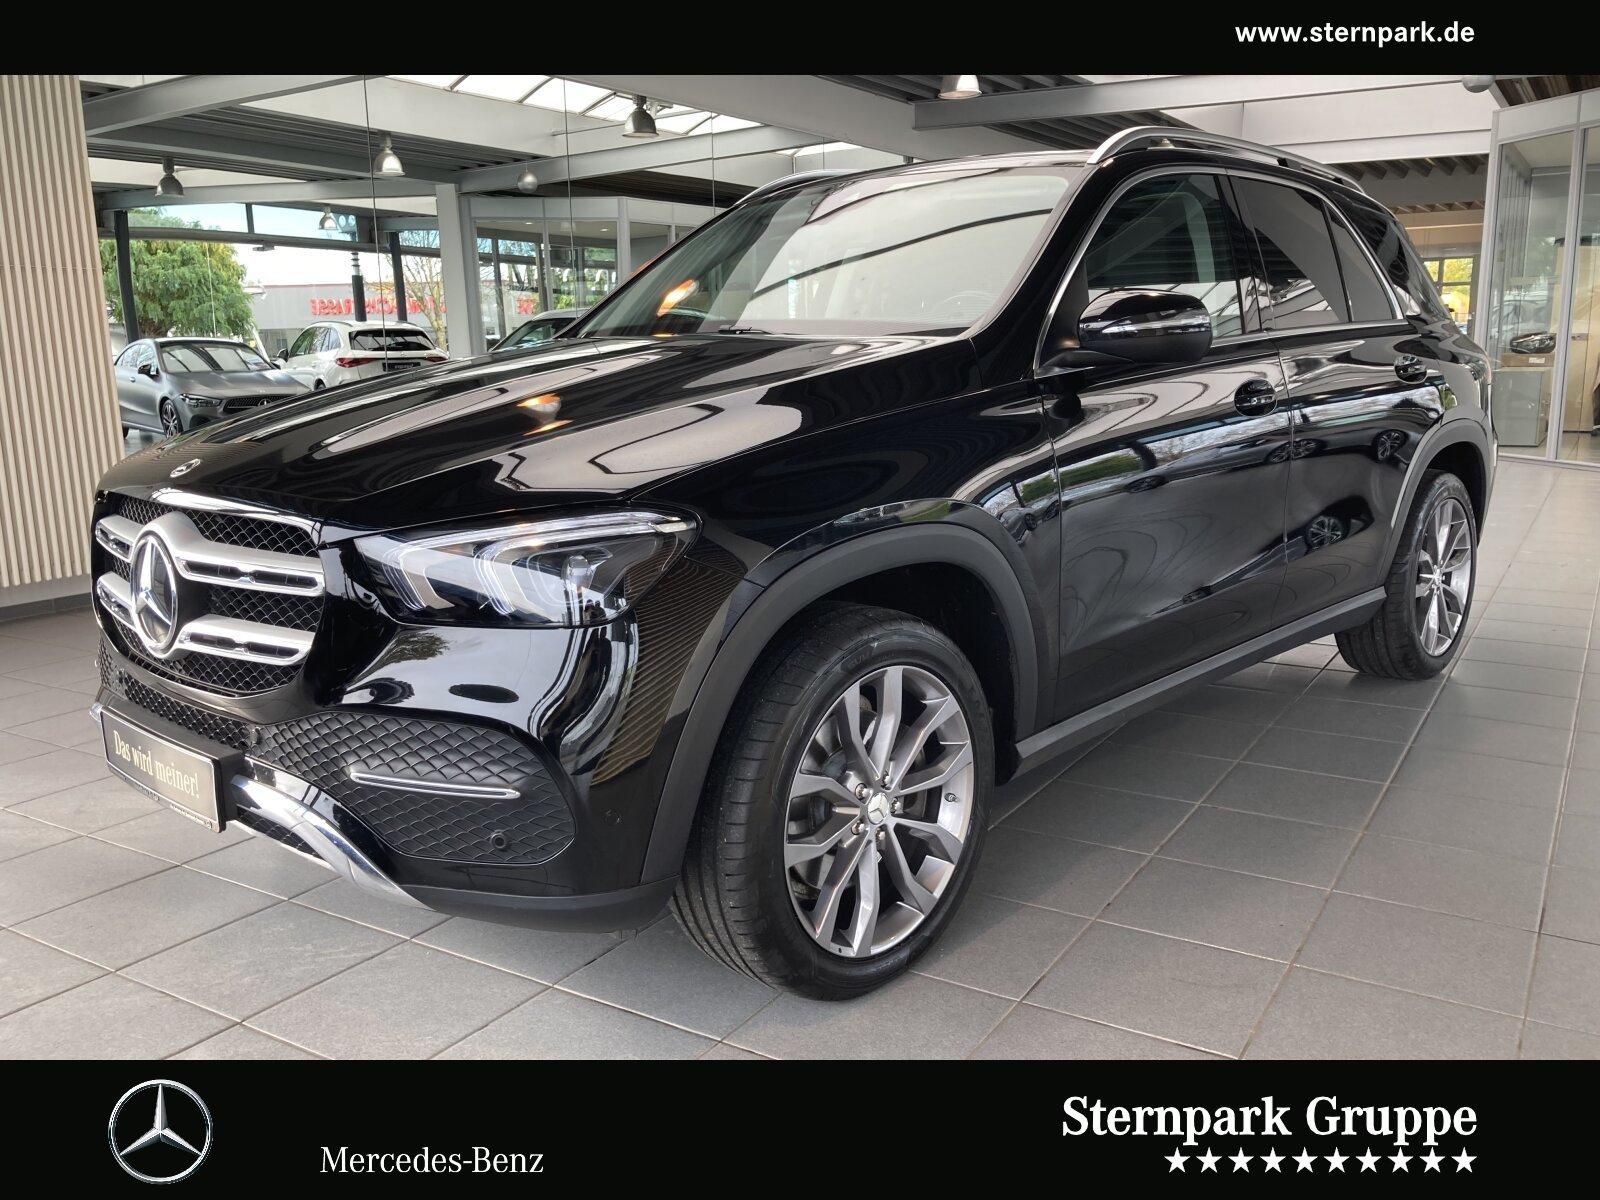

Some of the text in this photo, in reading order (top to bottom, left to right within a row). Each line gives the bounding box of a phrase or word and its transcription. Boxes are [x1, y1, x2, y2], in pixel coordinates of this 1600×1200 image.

[113, 730, 131, 761] Das
[132, 746, 153, 775] wird
[154, 761, 200, 799] meiner!
